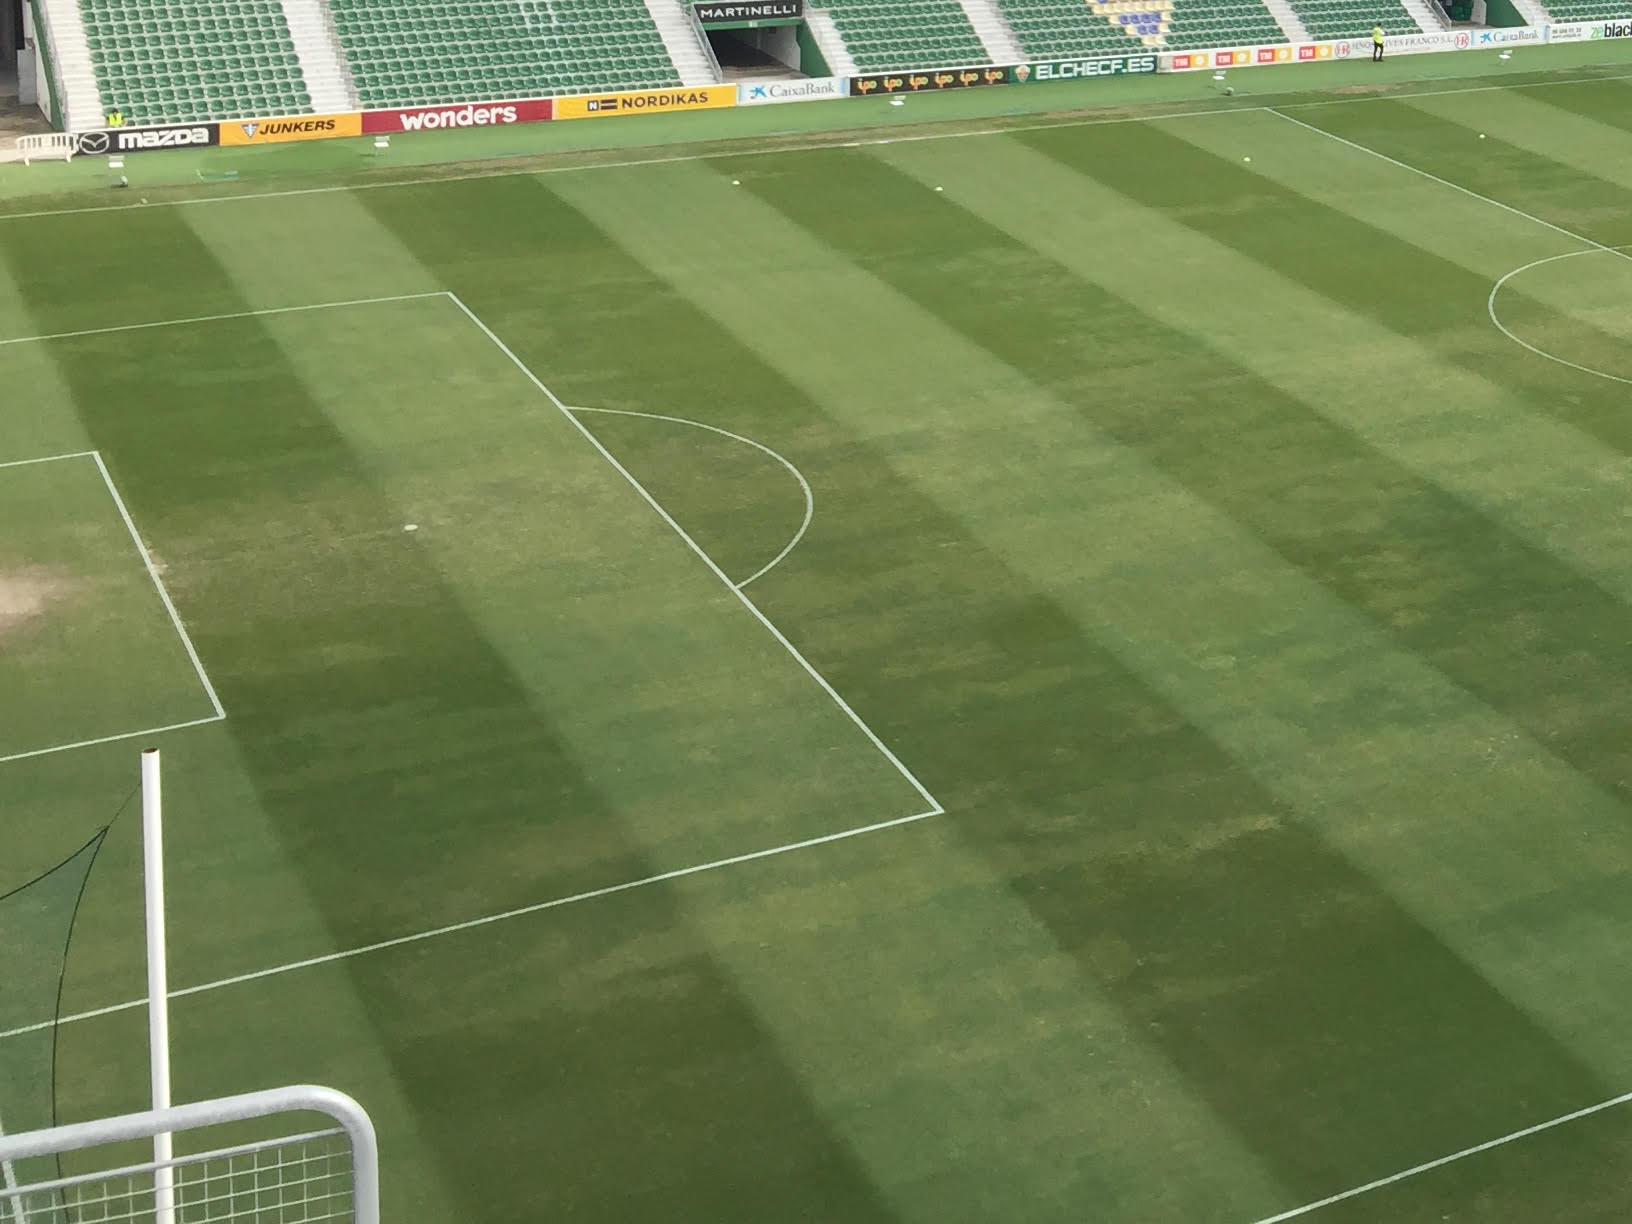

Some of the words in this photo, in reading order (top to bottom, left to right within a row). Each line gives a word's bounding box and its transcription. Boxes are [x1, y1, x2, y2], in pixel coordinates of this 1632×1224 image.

[700, 4, 797, 18] MARTINELLI
[1405, 37, 1439, 46] FRANCO
[1493, 30, 1539, 42] CaixaBank
[1036, 57, 1155, 80] ELCHECF.ES
[769, 83, 835, 98] CaixaBank
[621, 92, 709, 109] NORDIKAS
[400, 104, 518, 131] wonders
[259, 120, 336, 136] JUNKERS
